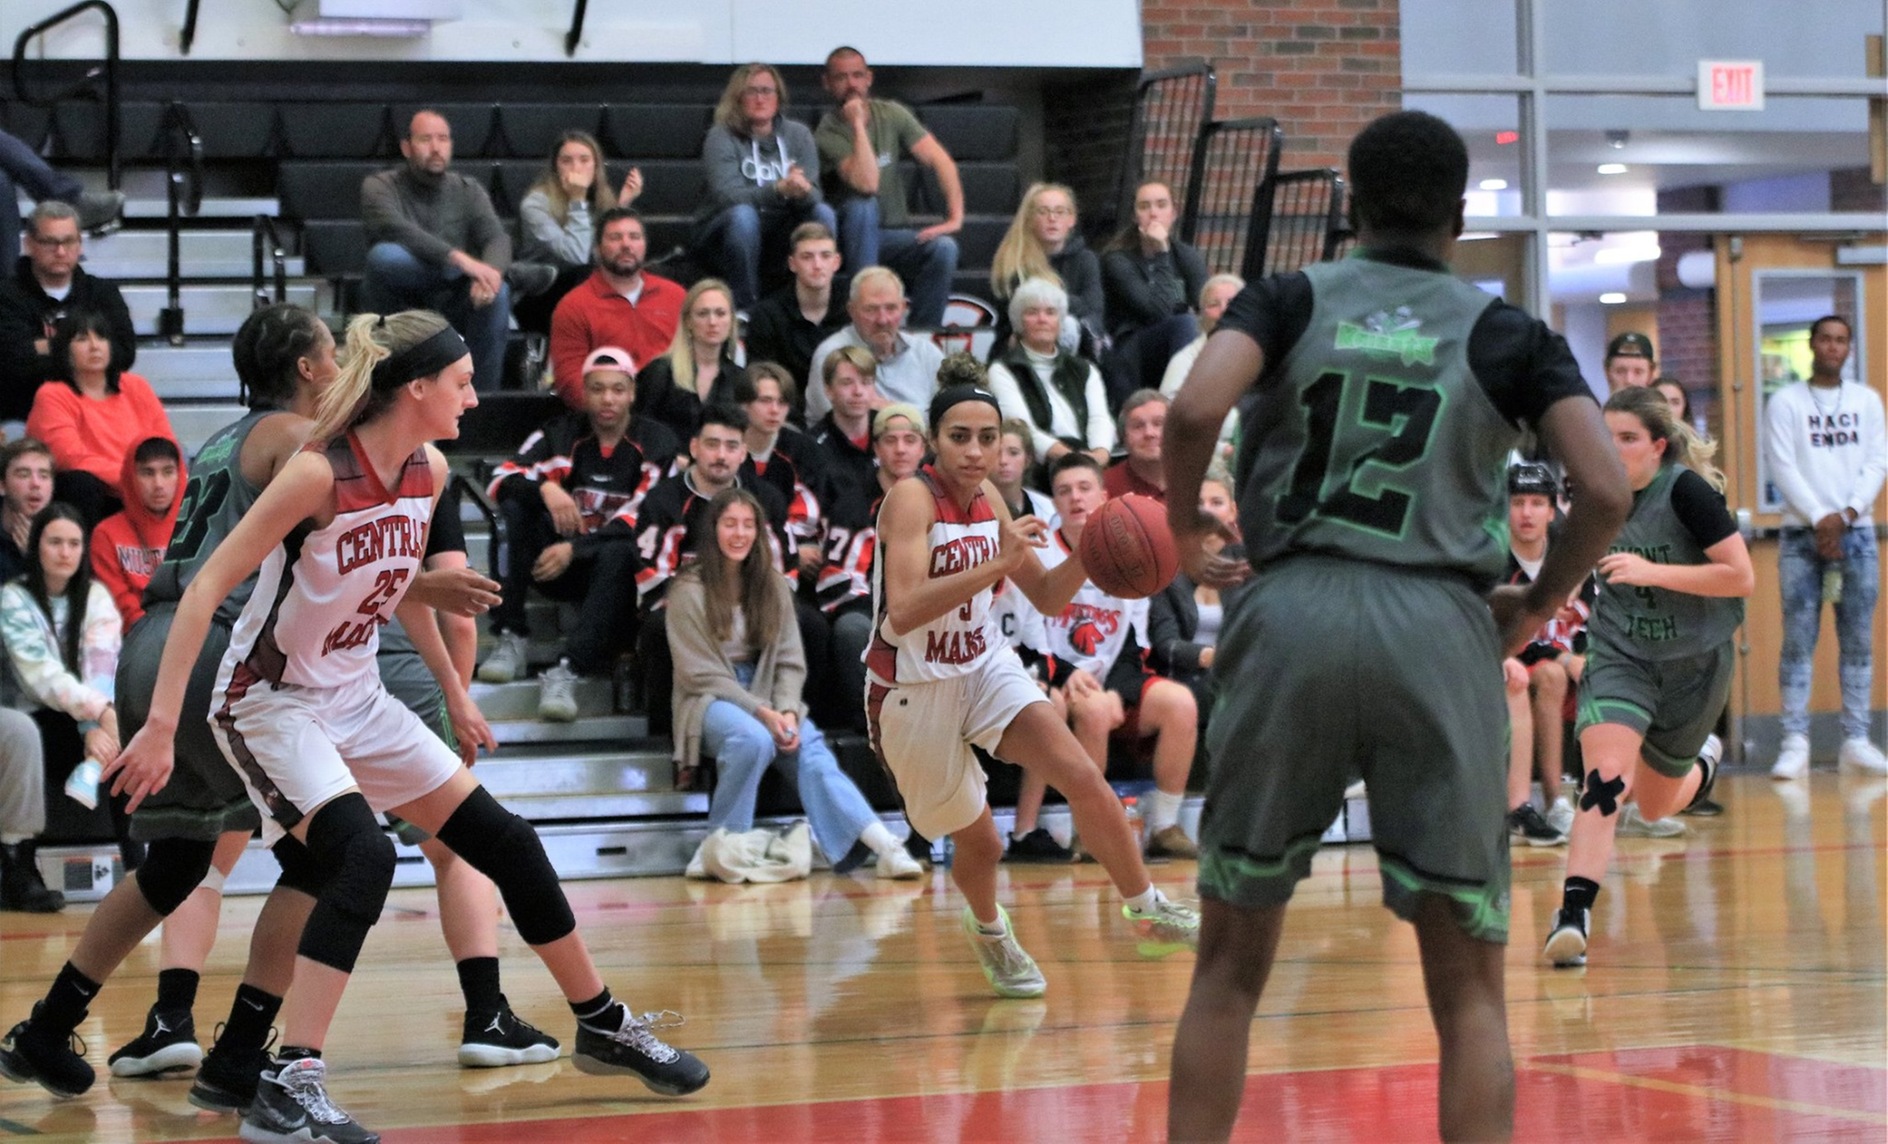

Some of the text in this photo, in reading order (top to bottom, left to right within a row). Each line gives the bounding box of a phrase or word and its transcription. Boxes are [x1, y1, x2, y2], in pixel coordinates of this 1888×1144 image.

[1711, 67, 1754, 104] EXIT
[1808, 413, 1859, 430] HACI
[1810, 431, 1860, 448] ENDA
[1274, 367, 1447, 541] 12
[636, 524, 660, 560] 4
[1001, 612, 1015, 636] C
[1625, 614, 1678, 640] TECH
